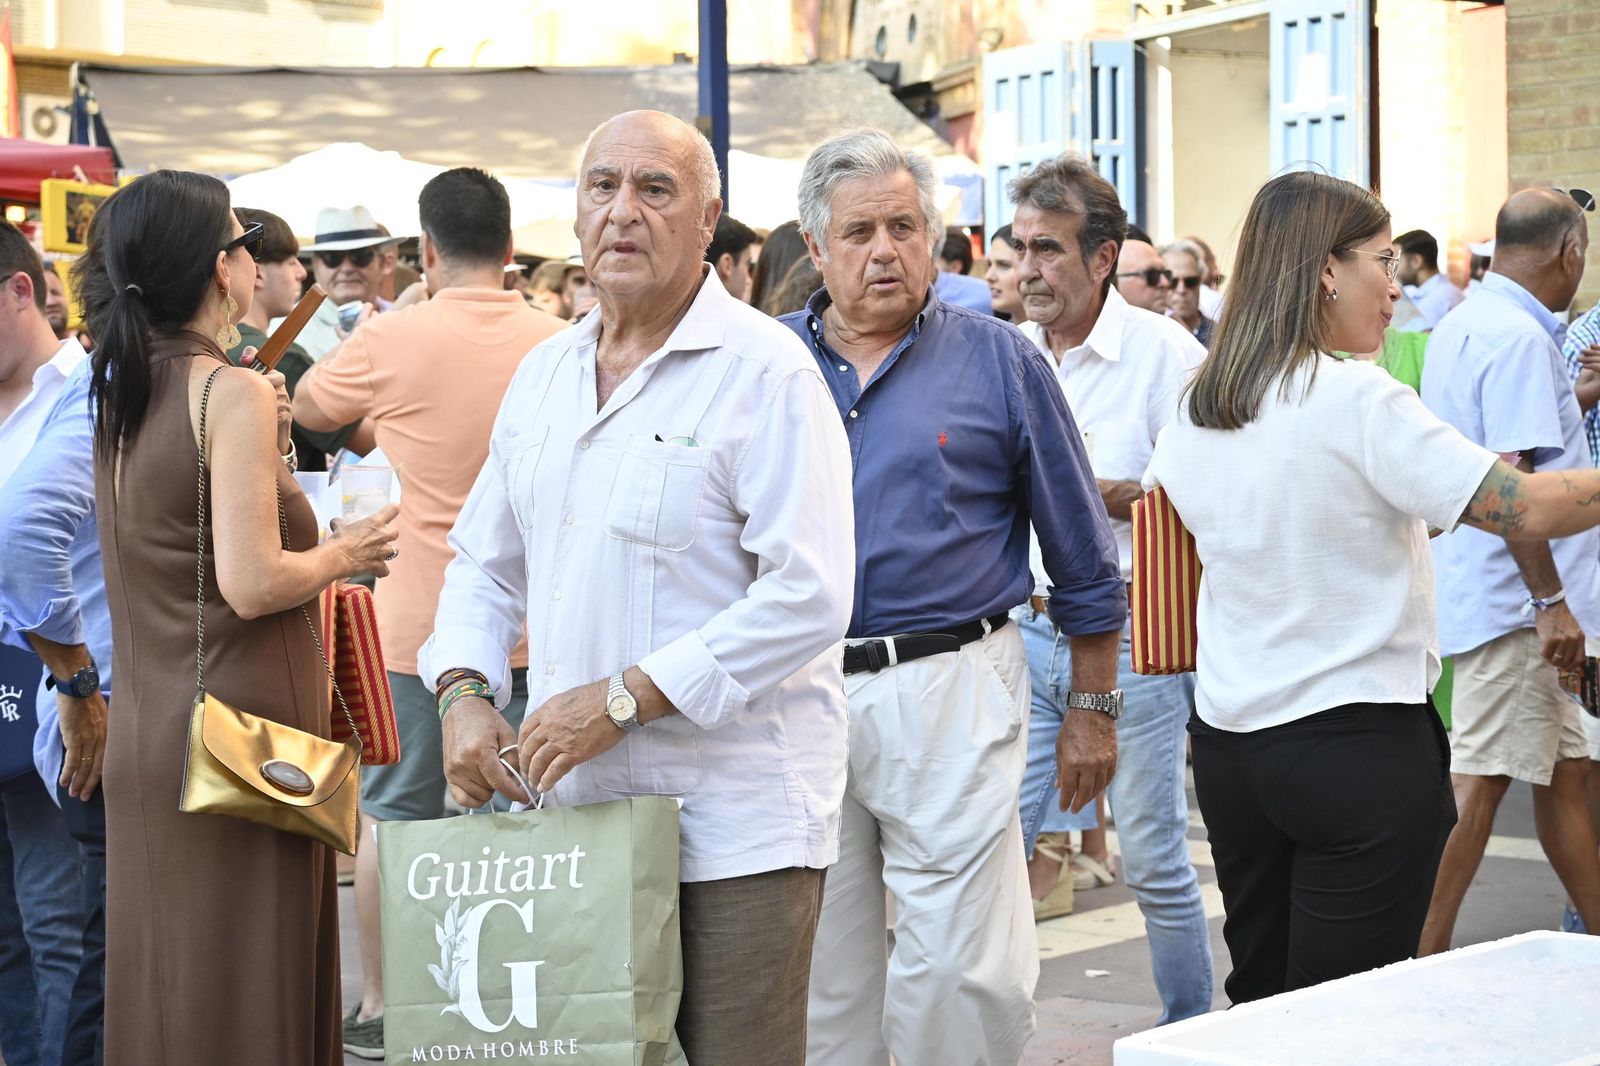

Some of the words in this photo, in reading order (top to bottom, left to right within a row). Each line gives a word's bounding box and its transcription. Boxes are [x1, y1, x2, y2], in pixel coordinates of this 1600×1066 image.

[407, 844, 586, 900] Guitart
[450, 898, 546, 1033] G
[412, 1043, 476, 1062] MODA
[483, 1038, 578, 1059] HOMBRE
